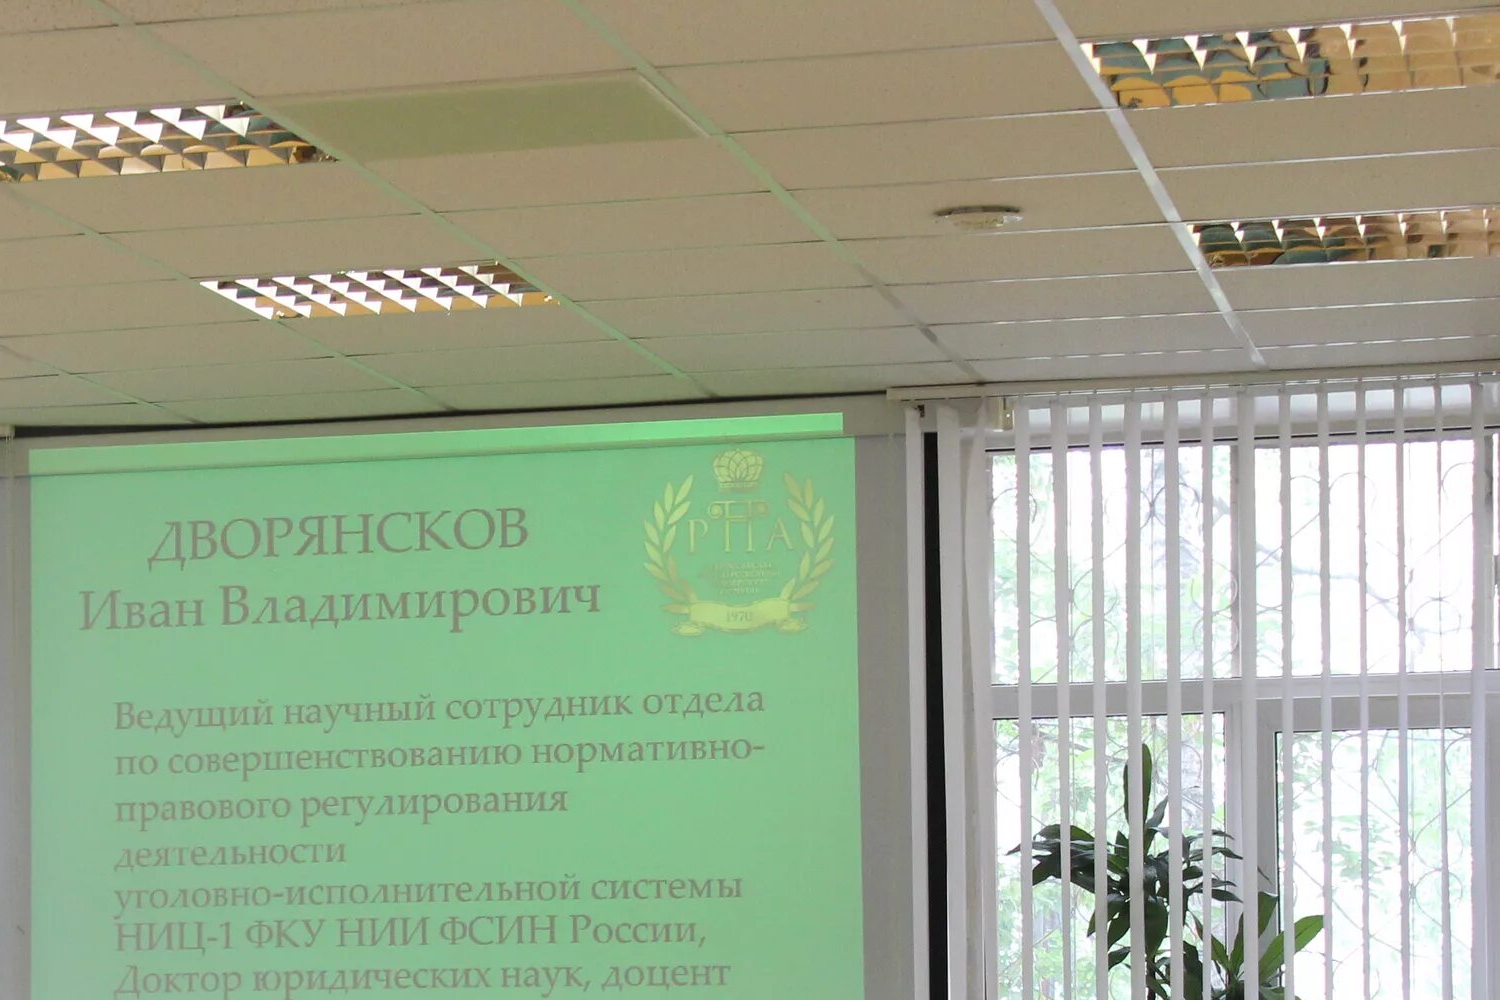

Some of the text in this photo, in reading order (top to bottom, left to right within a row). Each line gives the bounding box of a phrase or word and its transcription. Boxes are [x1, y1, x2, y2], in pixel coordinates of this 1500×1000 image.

[147, 507, 529, 572] ДВОРЯНСКОВ
[79, 584, 601, 634] Иван Владимирович
[114, 691, 765, 738] Ведущий научный сотрудник отдела
[115, 738, 766, 782] по совершенствованию нормативно-
[115, 791, 569, 832] правового регулирования
[113, 843, 347, 872] деятельности
[113, 873, 743, 920] уголовно-исполнительной системы
[114, 913, 706, 956] НИЦ-1 ФКУ НИИ ФСИН России,
[501, 965, 591, 999] наук,
[601, 964, 731, 992] доцент
